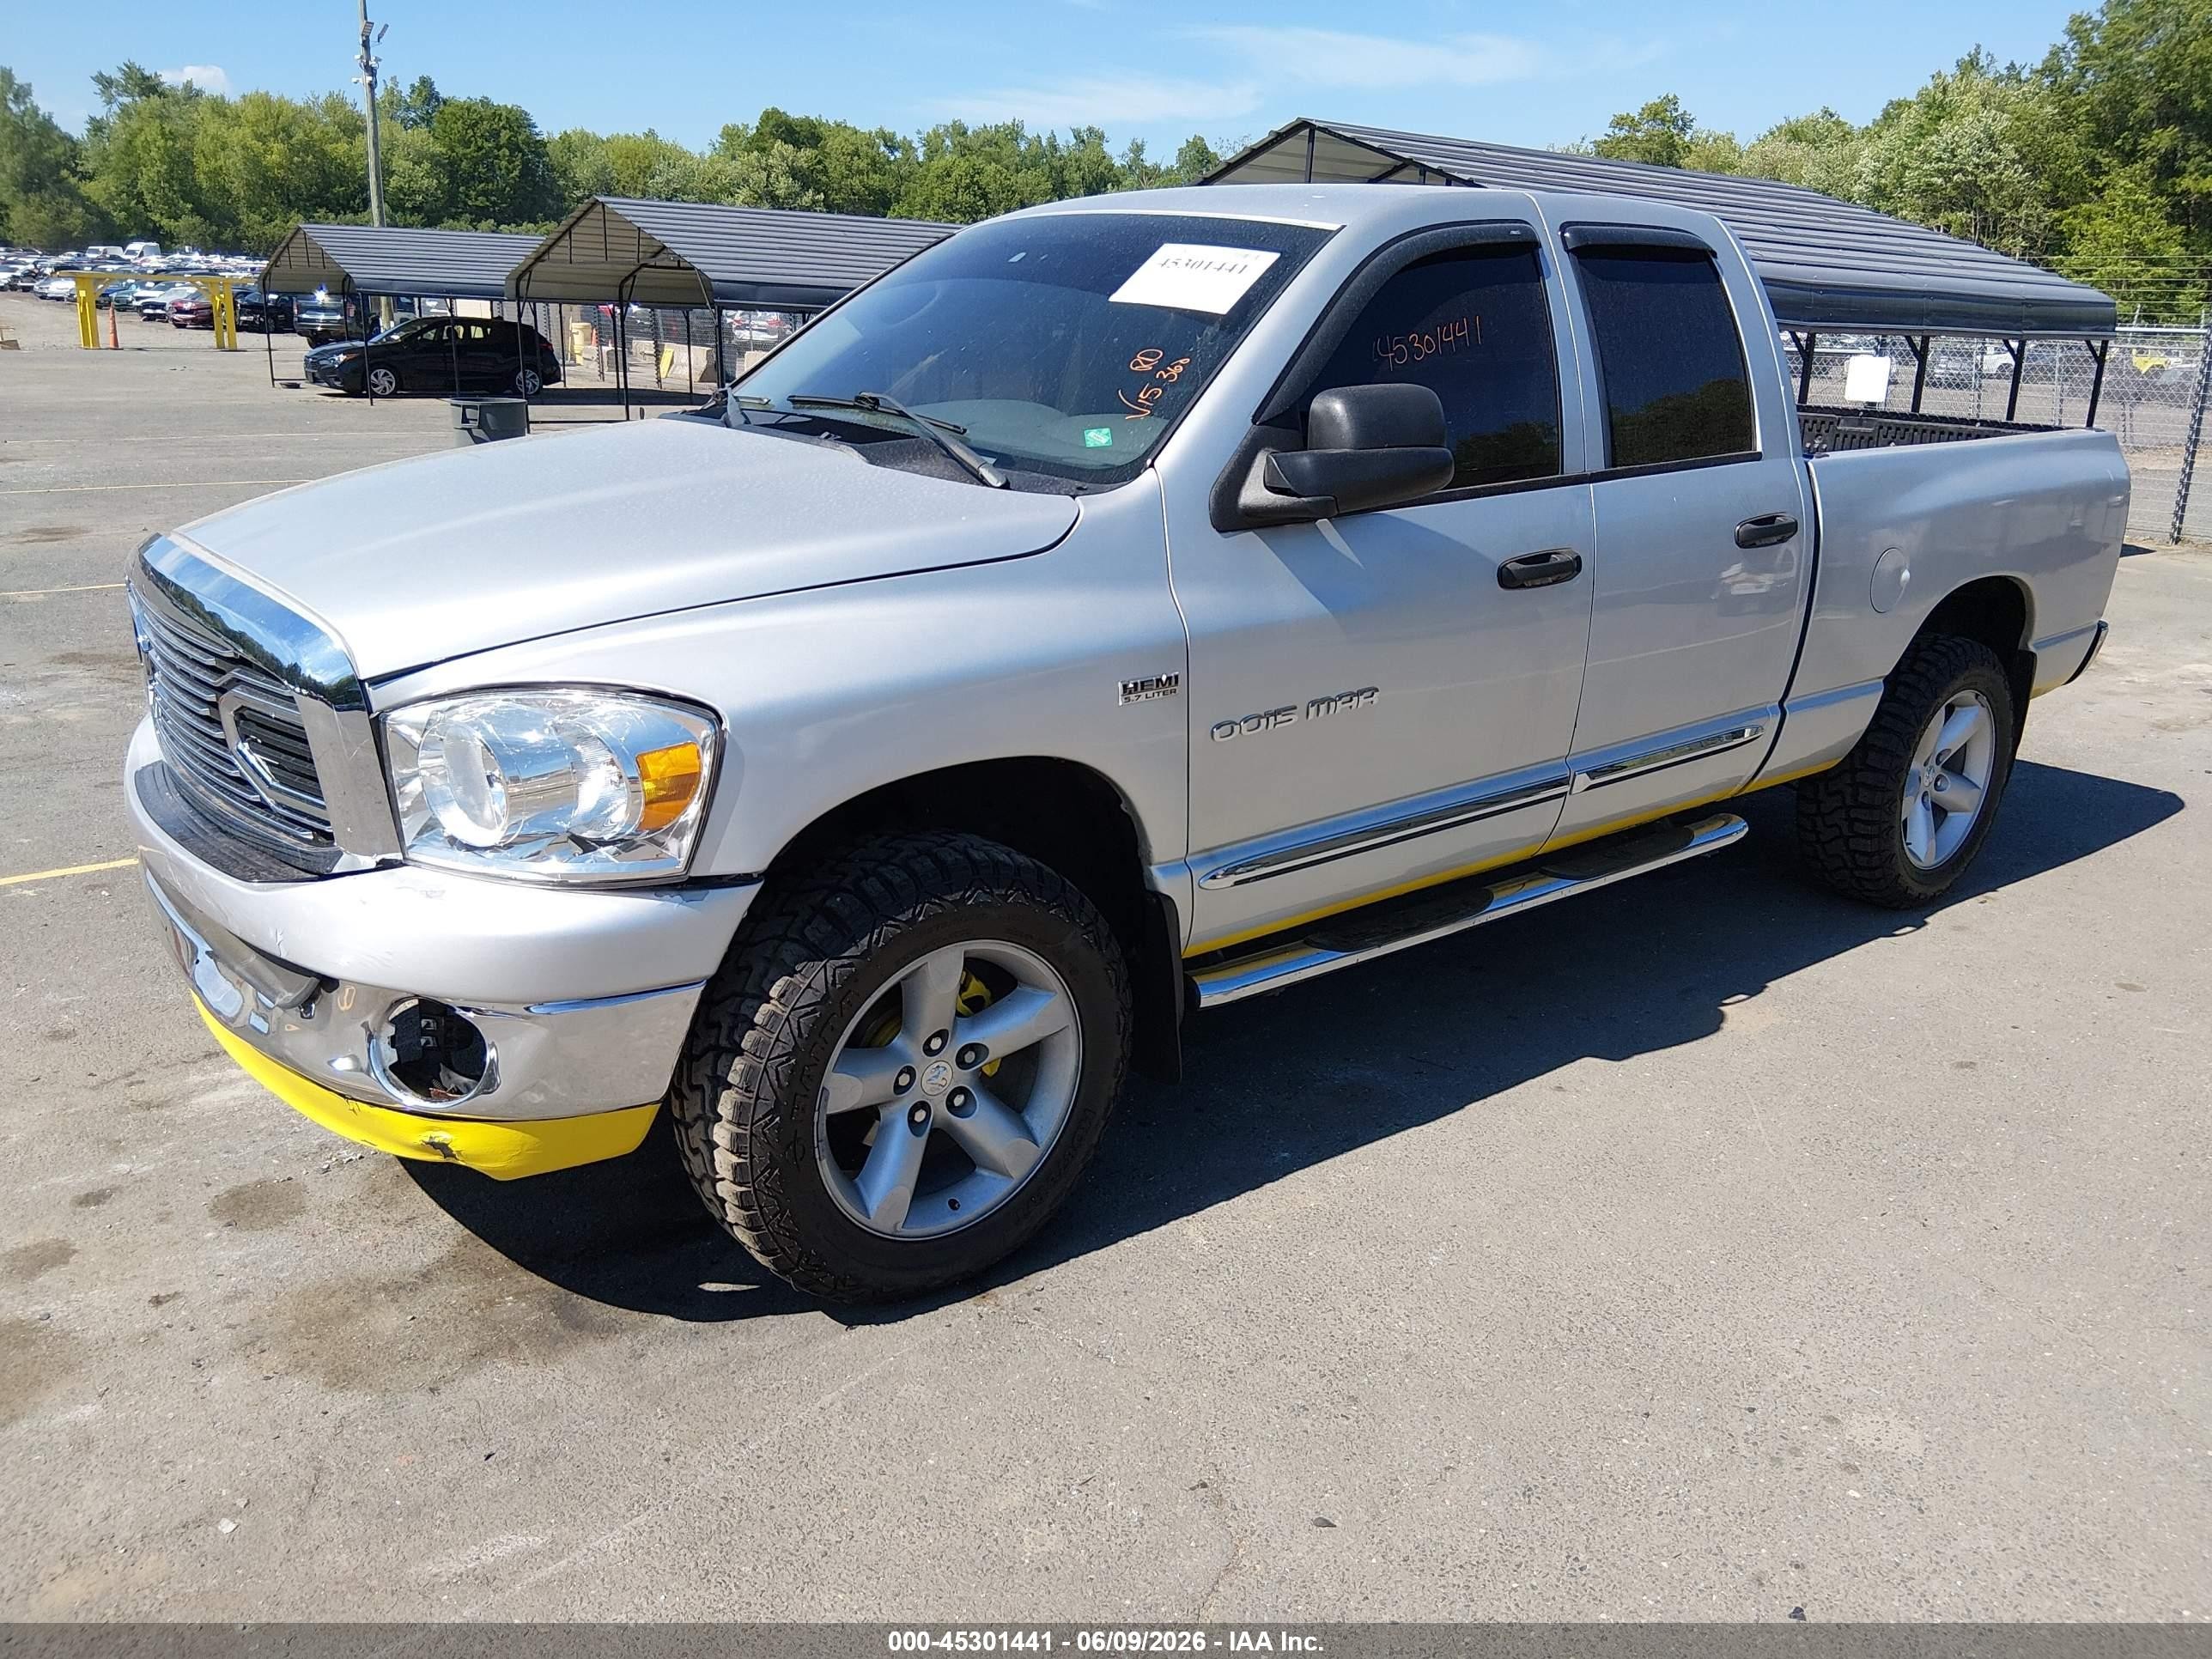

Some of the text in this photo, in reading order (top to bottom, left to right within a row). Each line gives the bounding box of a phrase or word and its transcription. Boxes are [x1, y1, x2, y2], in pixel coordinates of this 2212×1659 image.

[1158, 258, 1249, 275] 45301441
[1376, 315, 1481, 372] 45301441
[1121, 672, 1179, 696] HEMI
[1123, 688, 1177, 703] 5.7 LITER
[1306, 686, 1381, 721] MAR
